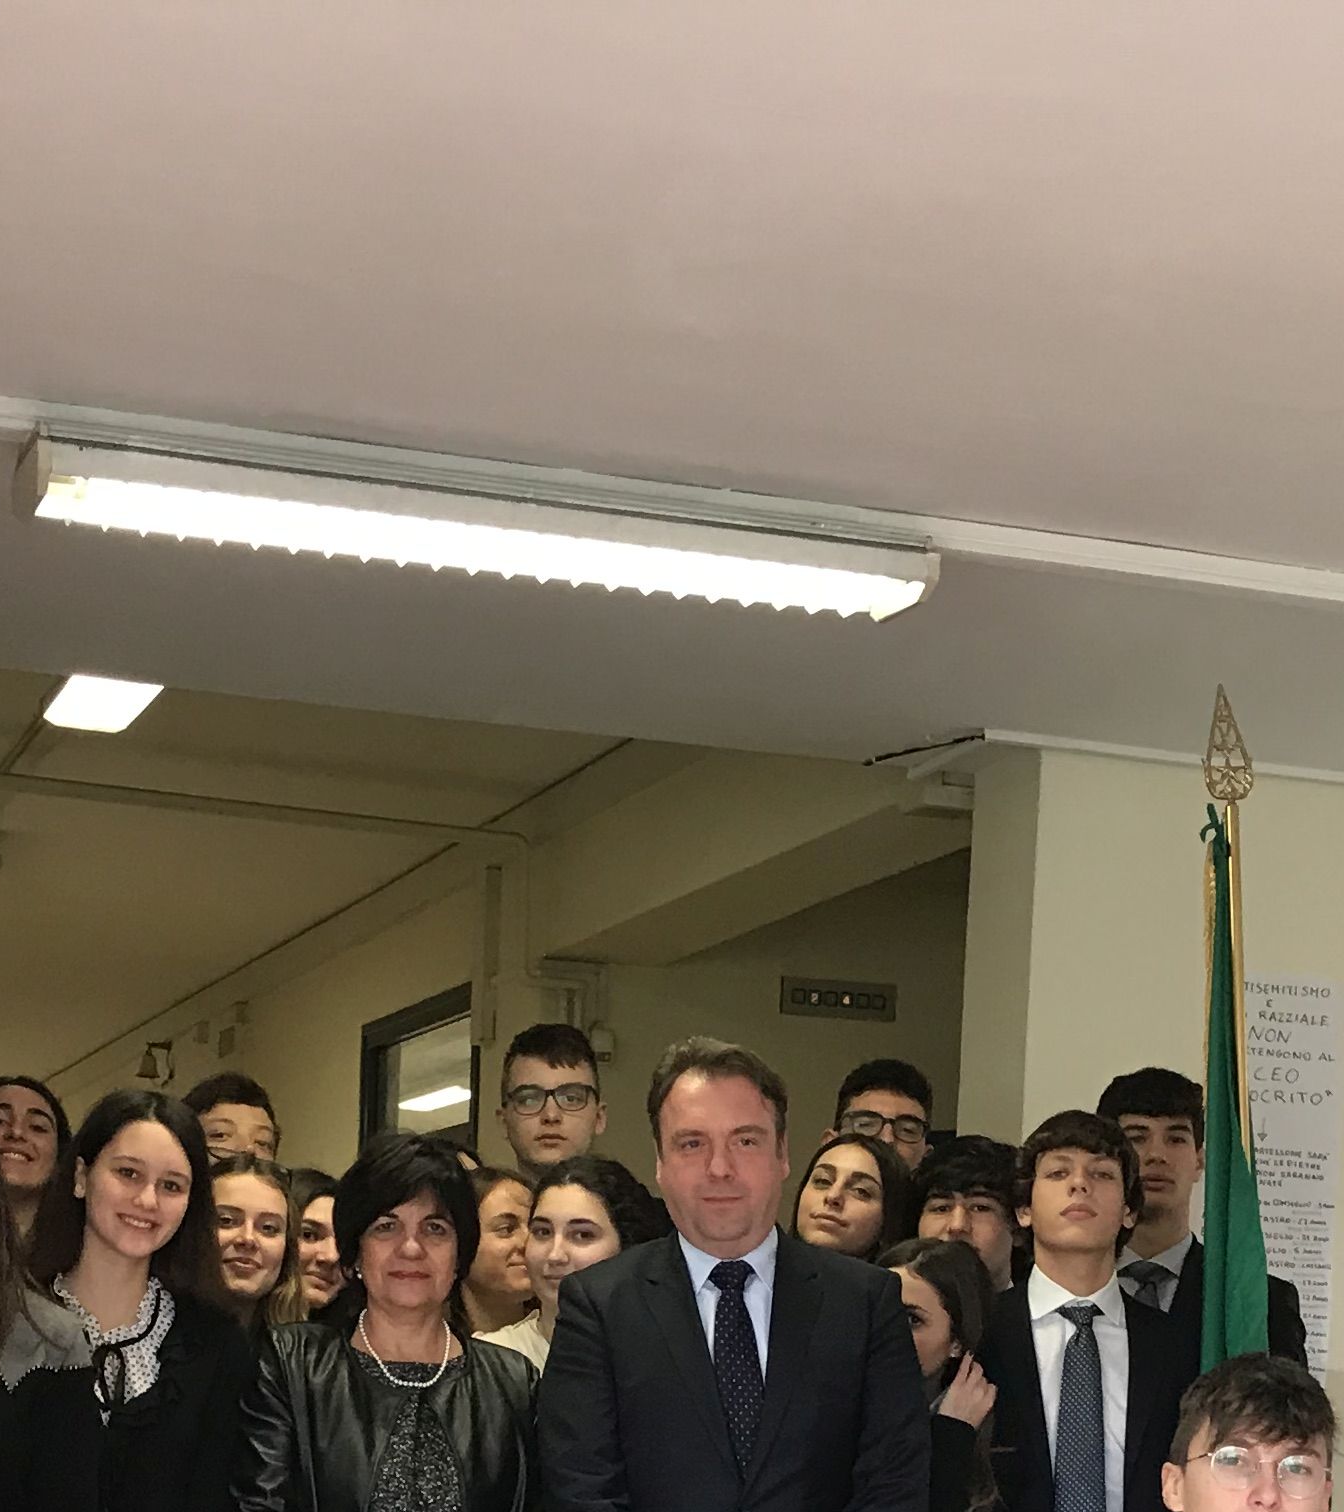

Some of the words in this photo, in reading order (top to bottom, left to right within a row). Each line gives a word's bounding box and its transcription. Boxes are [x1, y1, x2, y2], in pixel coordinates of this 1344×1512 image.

[1258, 1010, 1330, 1027] RAZZIALE
[1248, 1025, 1293, 1044] NON
[1247, 1046, 1311, 1061] TENGONO
[1318, 1052, 1336, 1062] AL
[1253, 1066, 1300, 1084] CEO
